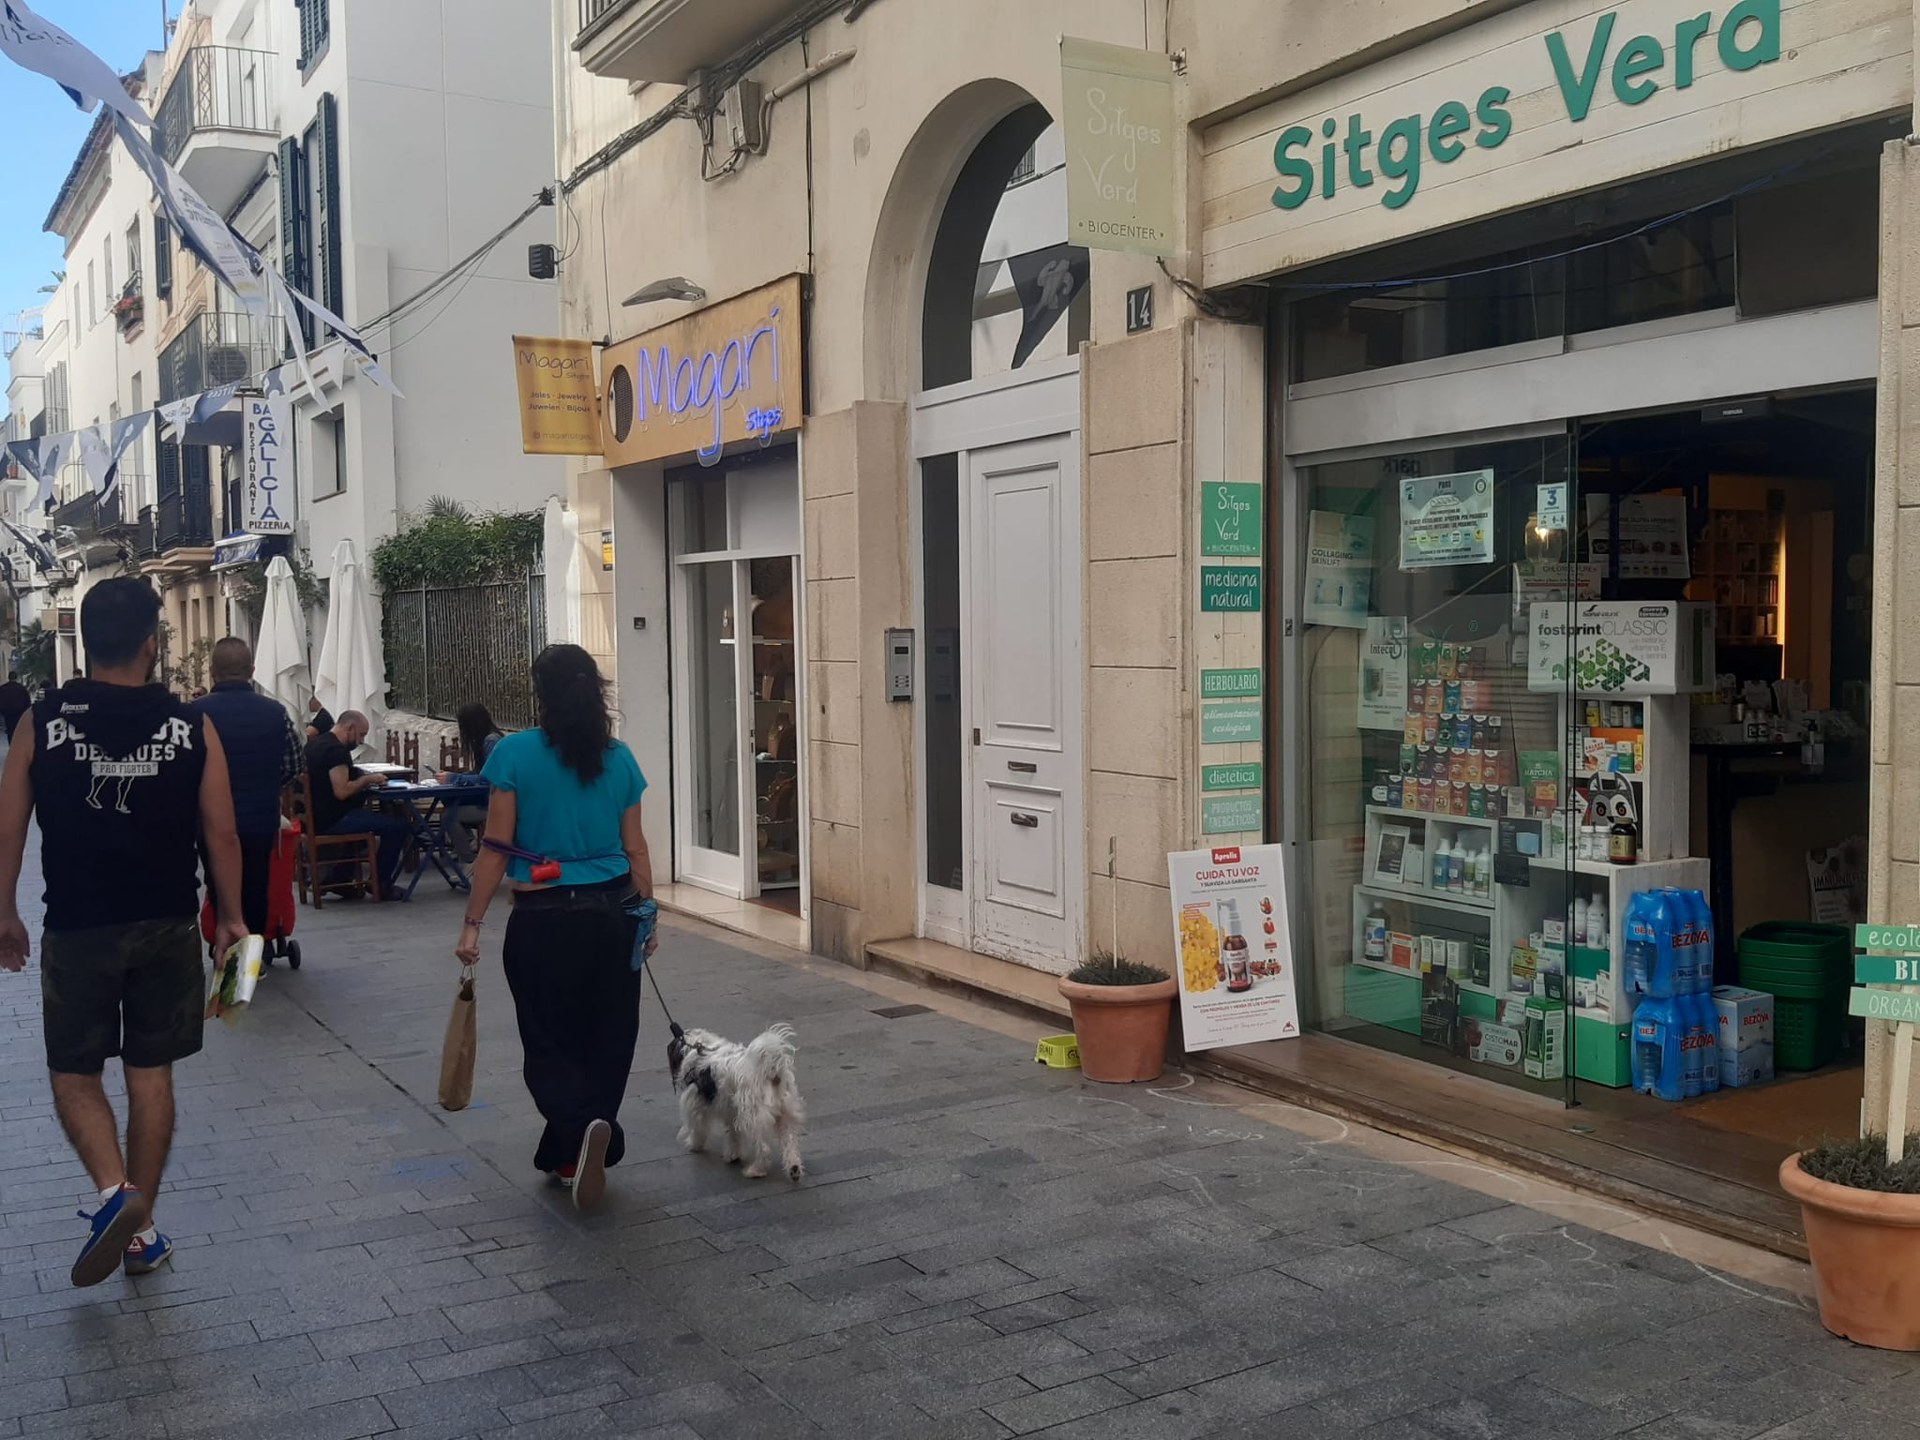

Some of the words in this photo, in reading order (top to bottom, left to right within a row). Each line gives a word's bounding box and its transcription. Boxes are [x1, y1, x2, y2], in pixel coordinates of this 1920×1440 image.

[1086, 87, 1161, 173] Sitges
[1271, 86, 1513, 209] Sitges
[1081, 152, 1139, 204] Verd
[1088, 219, 1157, 241] BIOCENTER
[1129, 290, 1151, 331] 14
[519, 350, 589, 378] Magari
[638, 306, 779, 456] Magari
[249, 422, 257, 515] RESTAURANTE
[258, 417, 280, 521] GALICIA
[1217, 486, 1251, 526] Sitges
[1547, 490, 1557, 506] 3
[249, 521, 291, 530] PIZZERIA
[1215, 518, 1240, 540] Verd
[1205, 570, 1257, 587] medicina
[1210, 590, 1252, 607] natural
[1204, 674, 1258, 691] HERBOLARIO
[1196, 869, 1225, 880] CUIDA
[1226, 868, 1239, 878] TU
[1240, 866, 1260, 876] VOZ
[1672, 928, 1710, 949] BEZOYA
[1743, 1012, 1770, 1026] BEZOYA
[1484, 1033, 1519, 1048] CISTOMAR
[1680, 1032, 1715, 1053] BEZOYA
